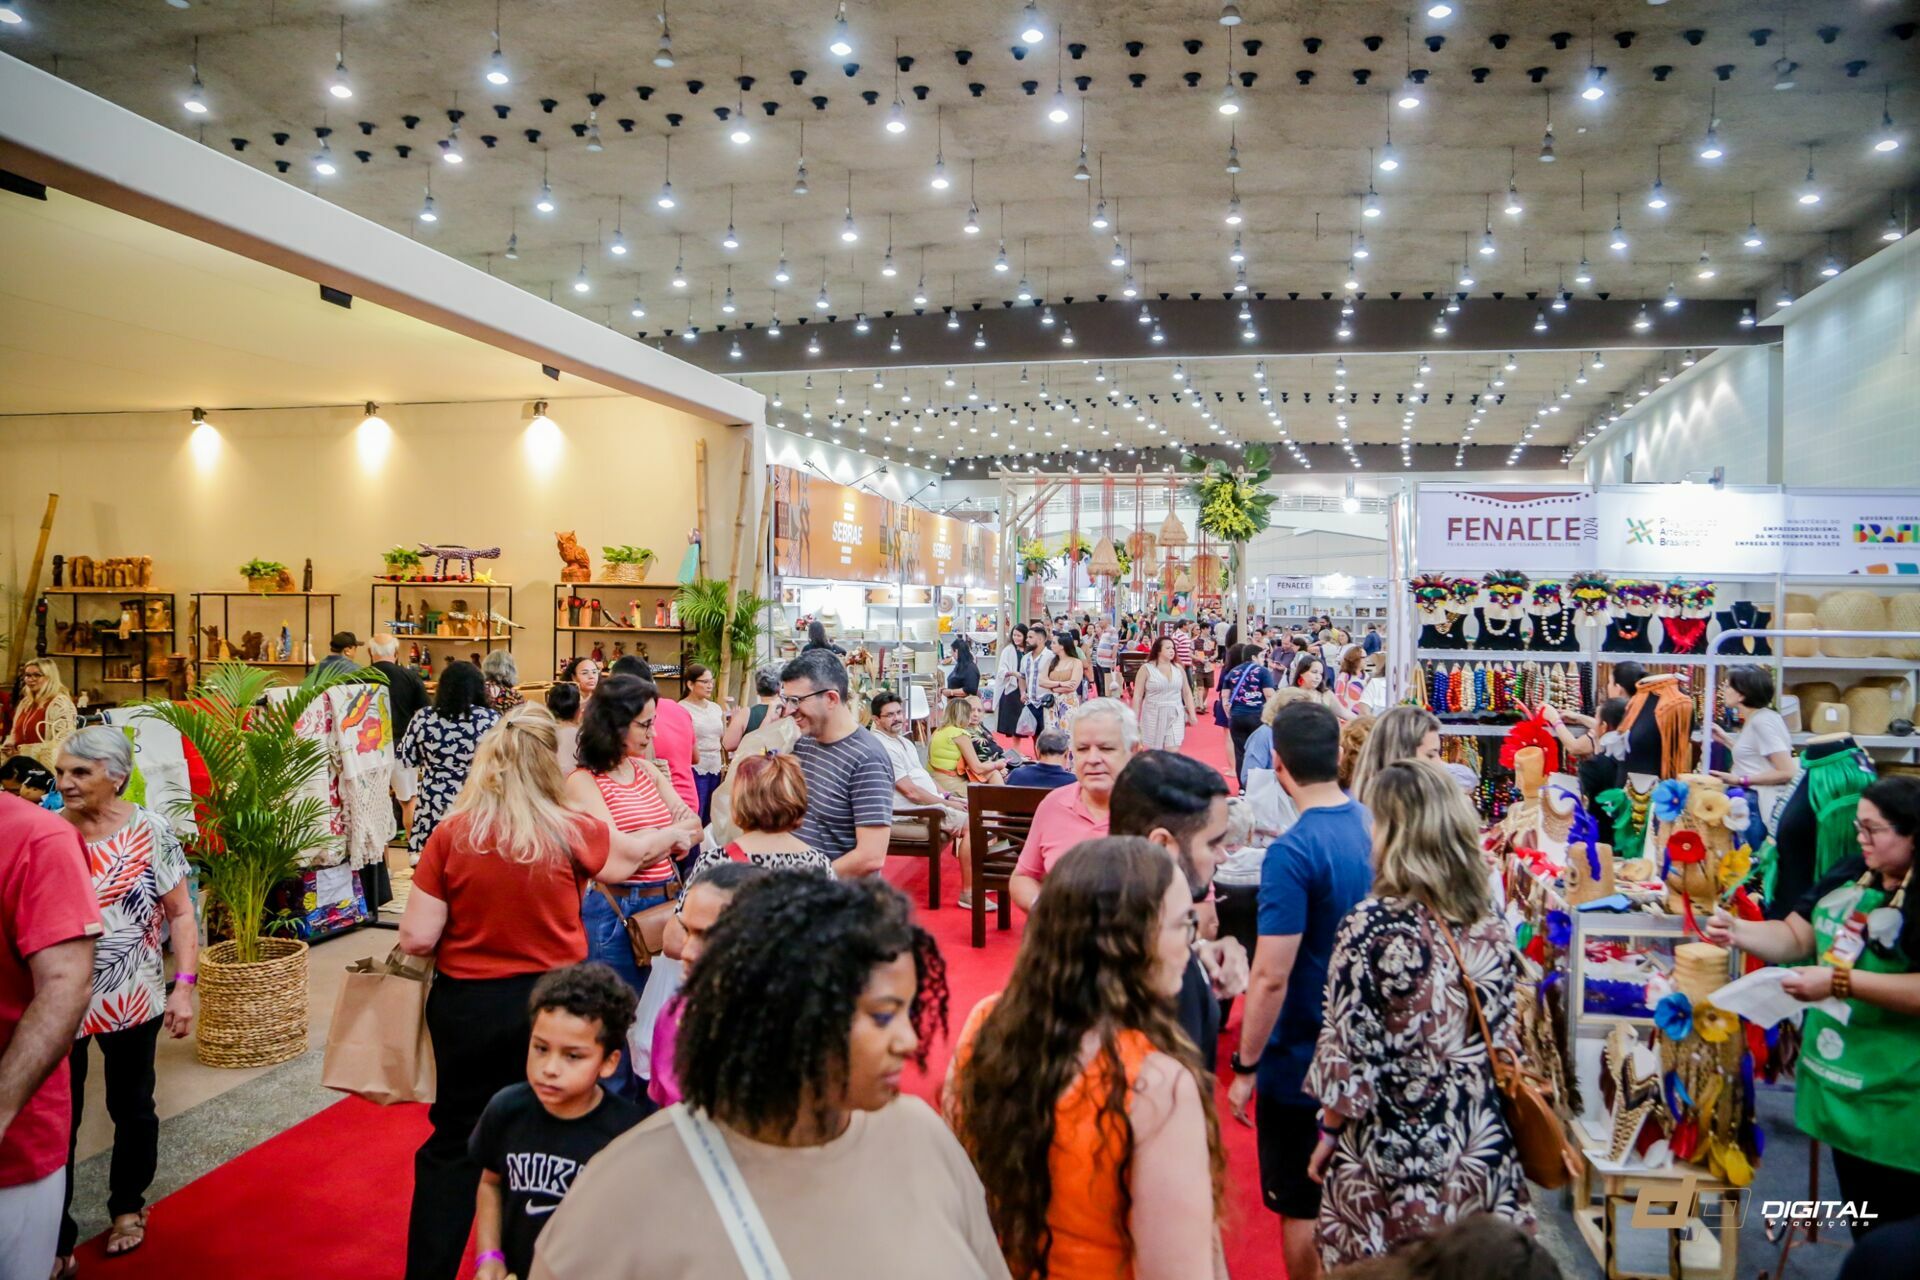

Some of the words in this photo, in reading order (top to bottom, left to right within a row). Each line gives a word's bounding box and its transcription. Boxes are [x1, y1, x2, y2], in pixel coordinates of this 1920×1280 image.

[832, 520, 864, 545] SEBRAE
[1448, 517, 1581, 541] FENACCE
[1583, 517, 1598, 540] 2024
[1277, 582, 1310, 590] FENACCE
[507, 1152, 585, 1198] NIK
